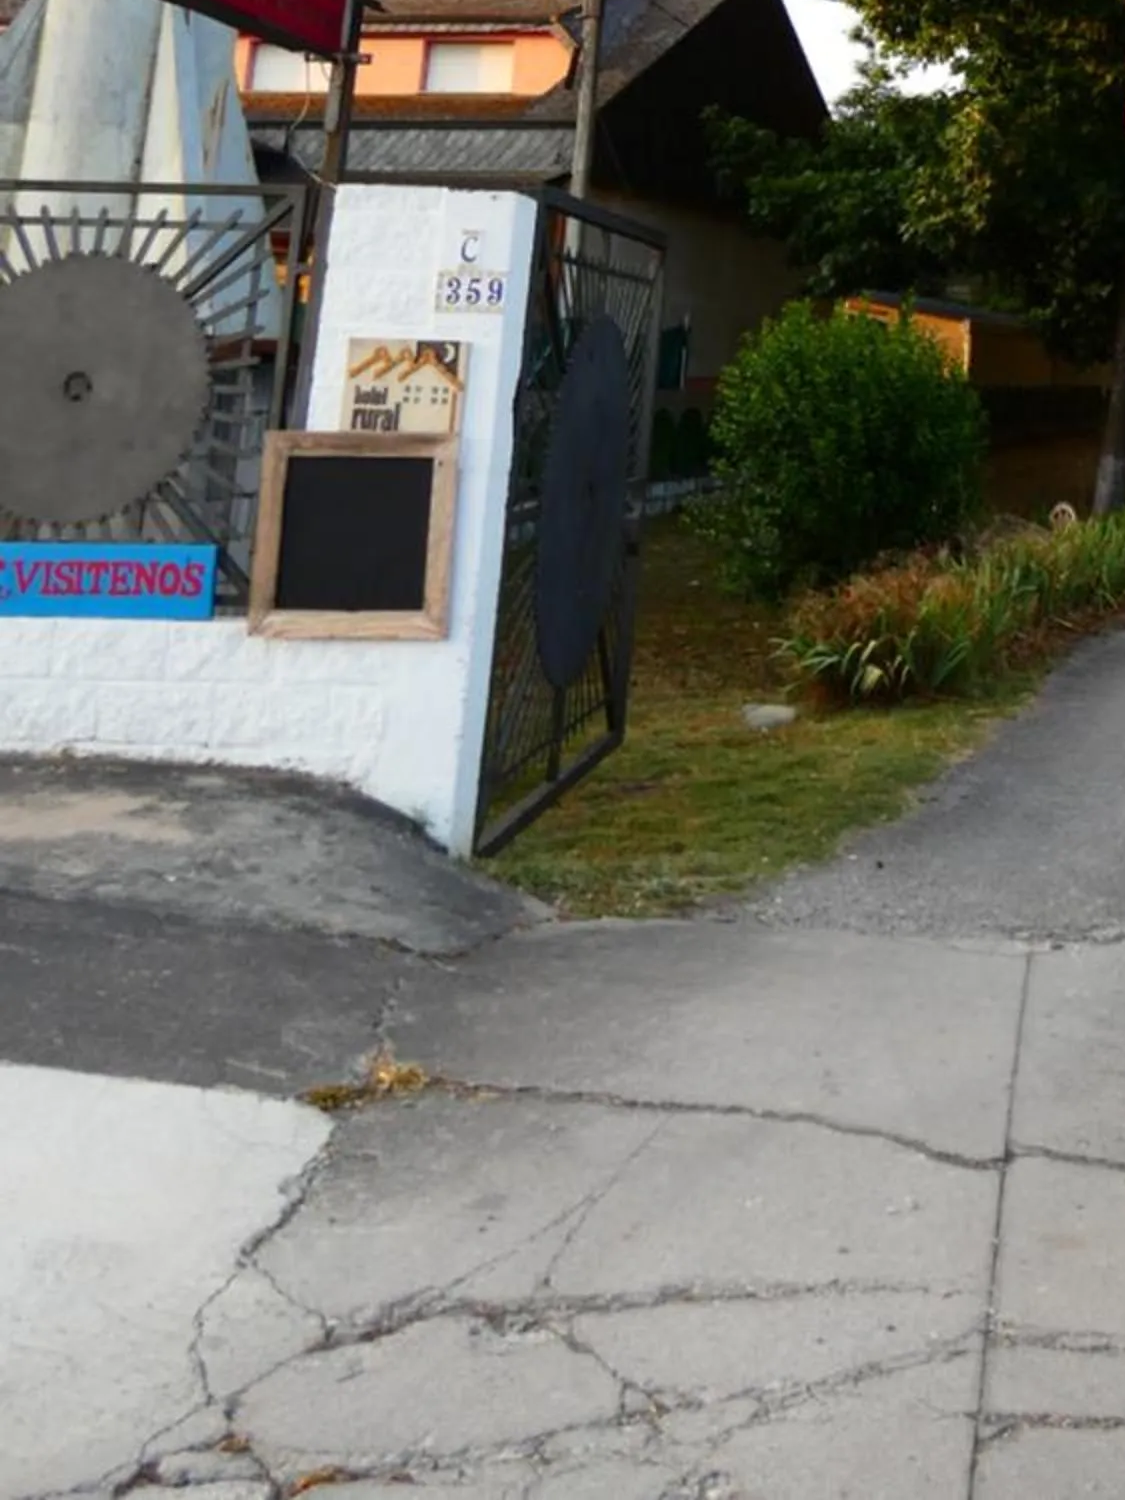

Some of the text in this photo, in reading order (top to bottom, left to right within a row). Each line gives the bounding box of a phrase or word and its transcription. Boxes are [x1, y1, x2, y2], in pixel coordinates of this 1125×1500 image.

[445, 277, 504, 306] 359
[351, 402, 401, 431] rural
[14, 559, 206, 597] VISITENOS
